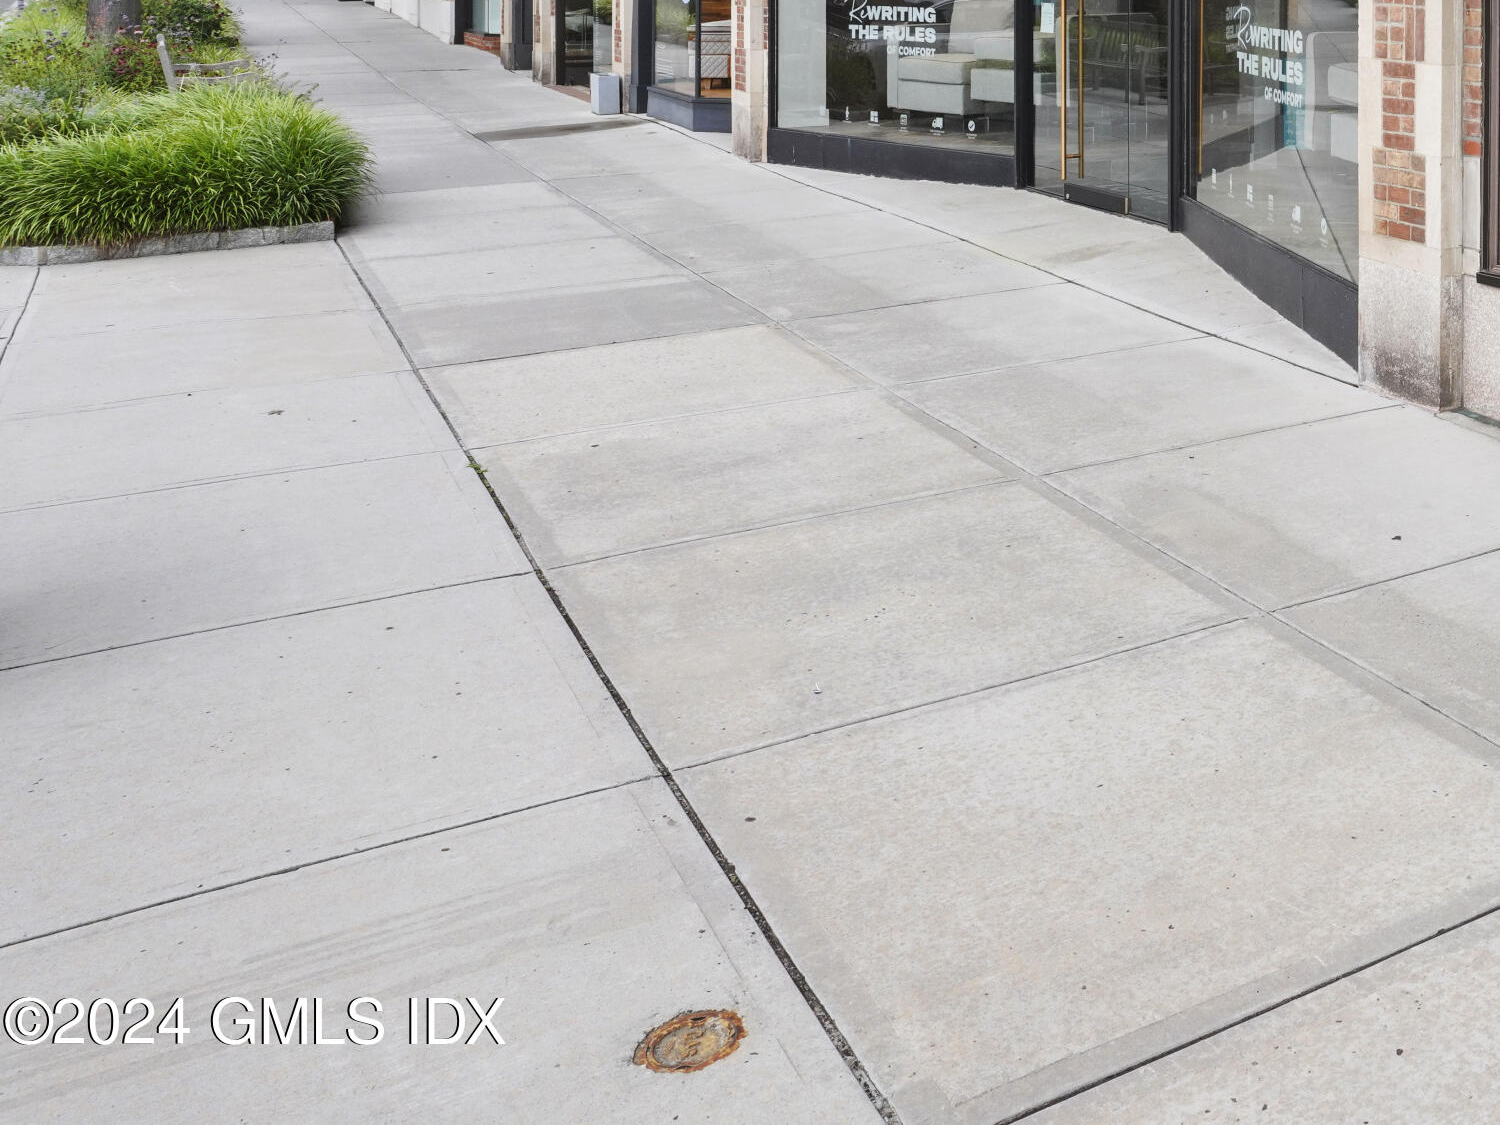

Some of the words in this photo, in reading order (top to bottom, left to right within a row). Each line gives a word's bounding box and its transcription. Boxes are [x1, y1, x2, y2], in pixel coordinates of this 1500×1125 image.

[848, 24, 879, 40] THE
[882, 25, 937, 44] RULES
[886, 45, 897, 55] OF
[898, 45, 936, 58] COMFORT
[1236, 50, 1259, 77] THE
[1261, 55, 1304, 86] RULES
[1264, 86, 1273, 100] OF
[1273, 87, 1303, 108] COMFORT
